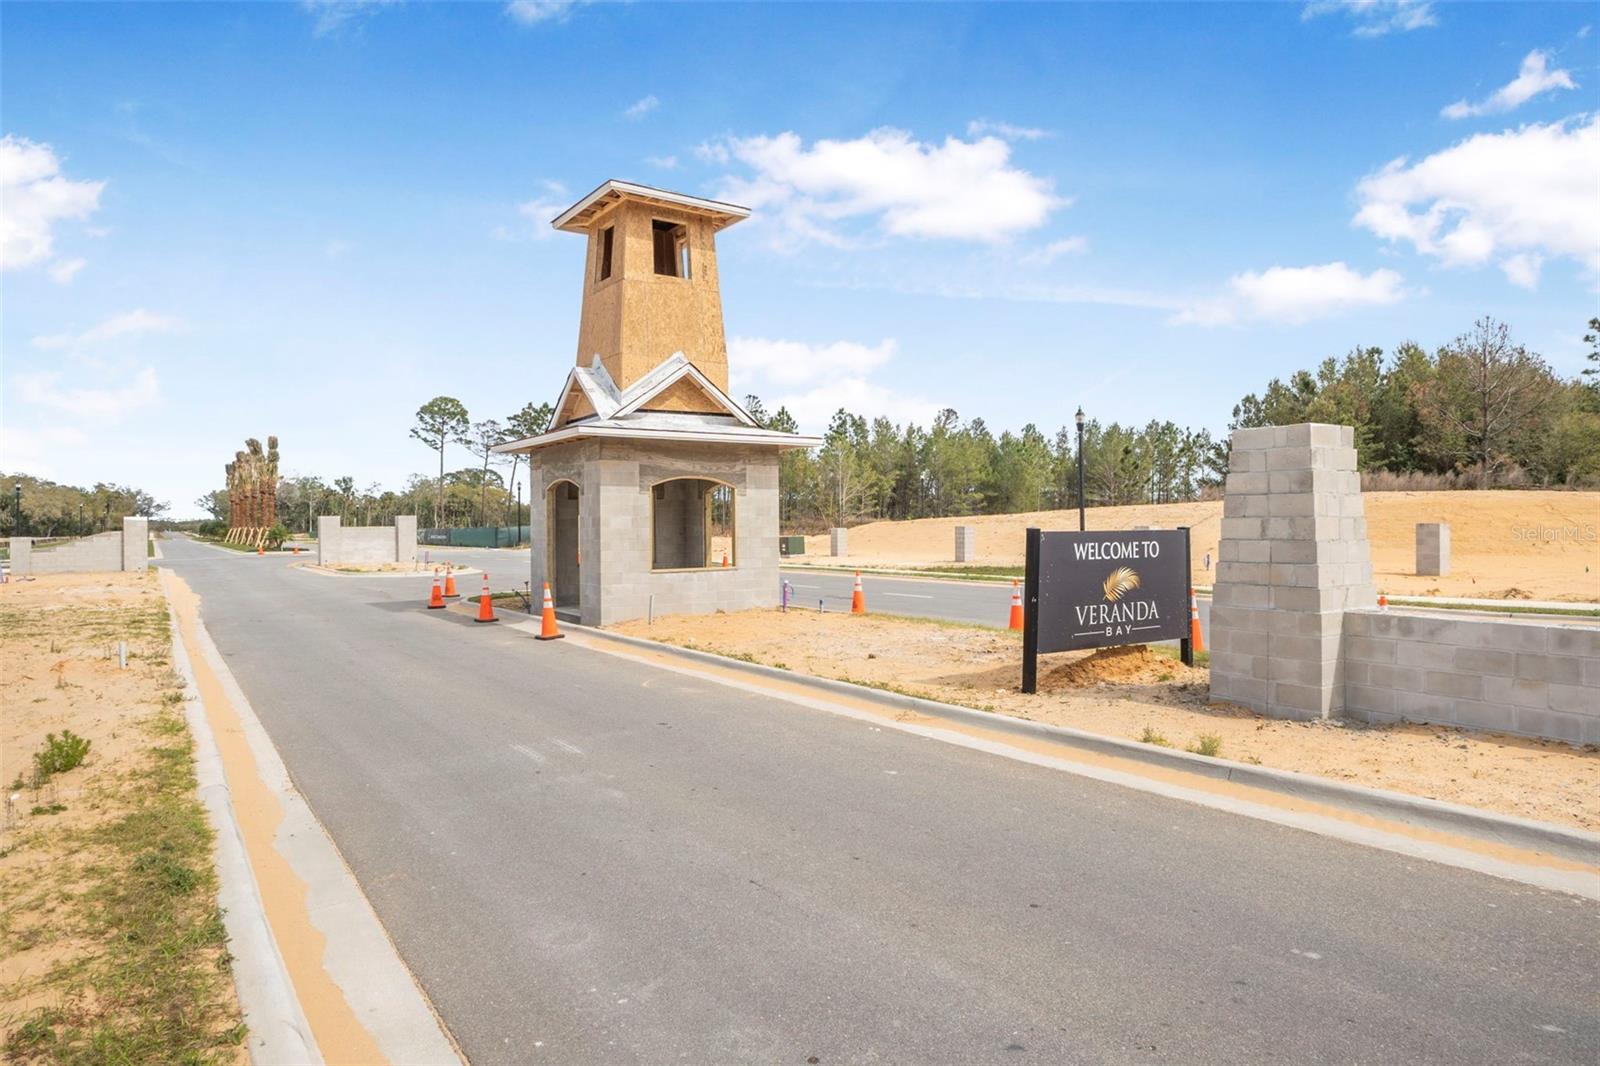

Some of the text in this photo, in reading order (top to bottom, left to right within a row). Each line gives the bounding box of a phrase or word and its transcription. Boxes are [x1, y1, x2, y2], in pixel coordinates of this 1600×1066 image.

[1074, 541, 1160, 560] WELCOME TO
[1075, 601, 1160, 626] VERANDA
[1105, 626, 1133, 637] BAY
